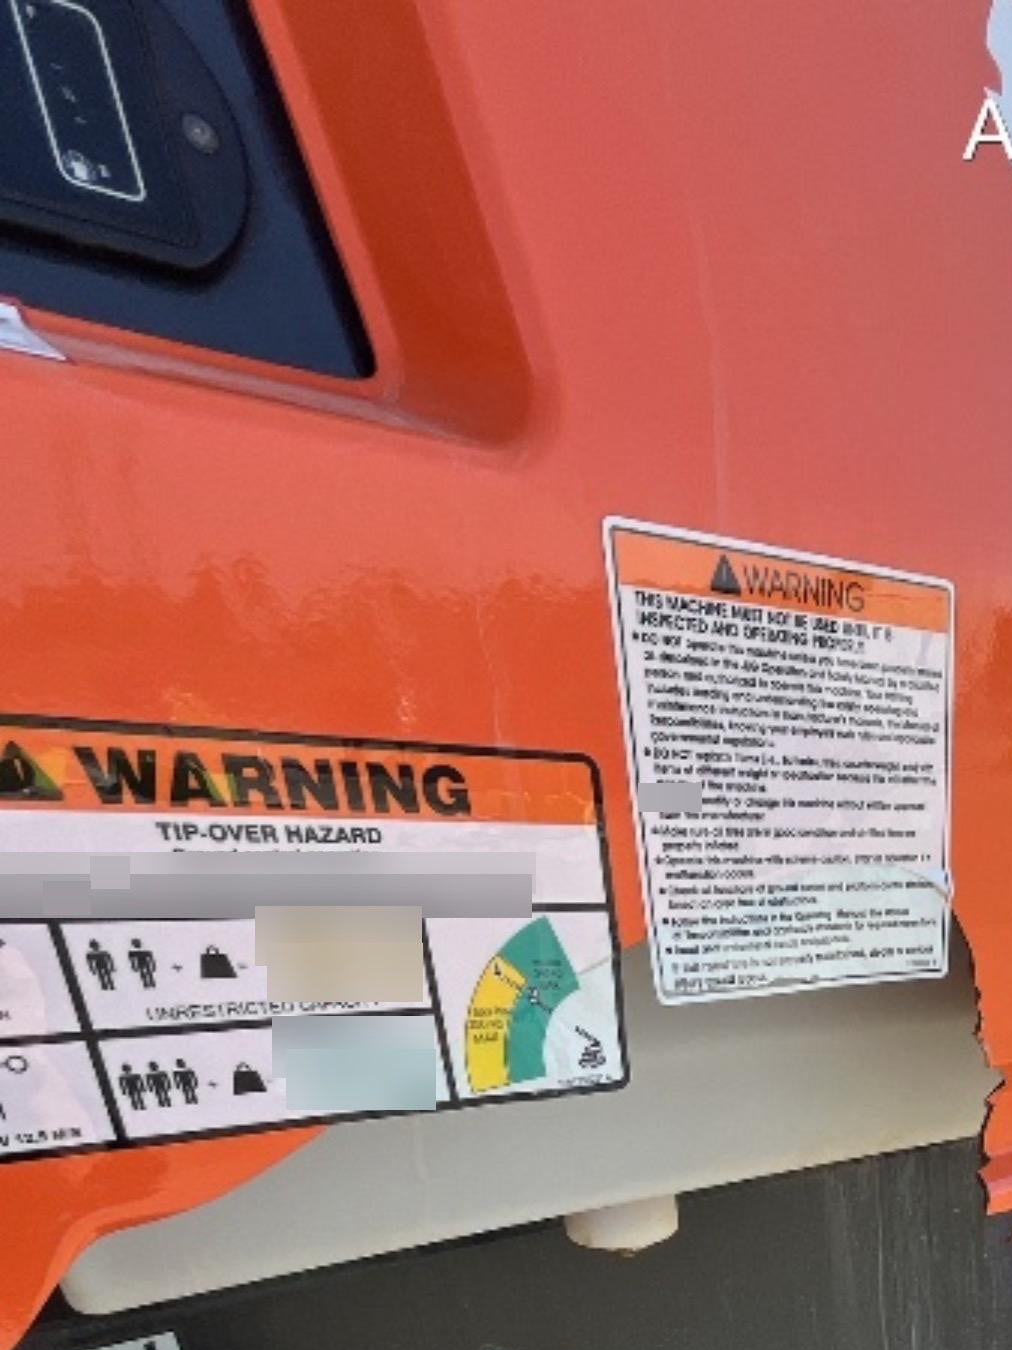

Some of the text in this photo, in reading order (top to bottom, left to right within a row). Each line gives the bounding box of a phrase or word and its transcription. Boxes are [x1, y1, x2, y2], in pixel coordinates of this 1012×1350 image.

[743, 563, 865, 613] WARNING
[73, 745, 472, 817] WARNING
[155, 821, 383, 845] TIP-OVER HAZARD
